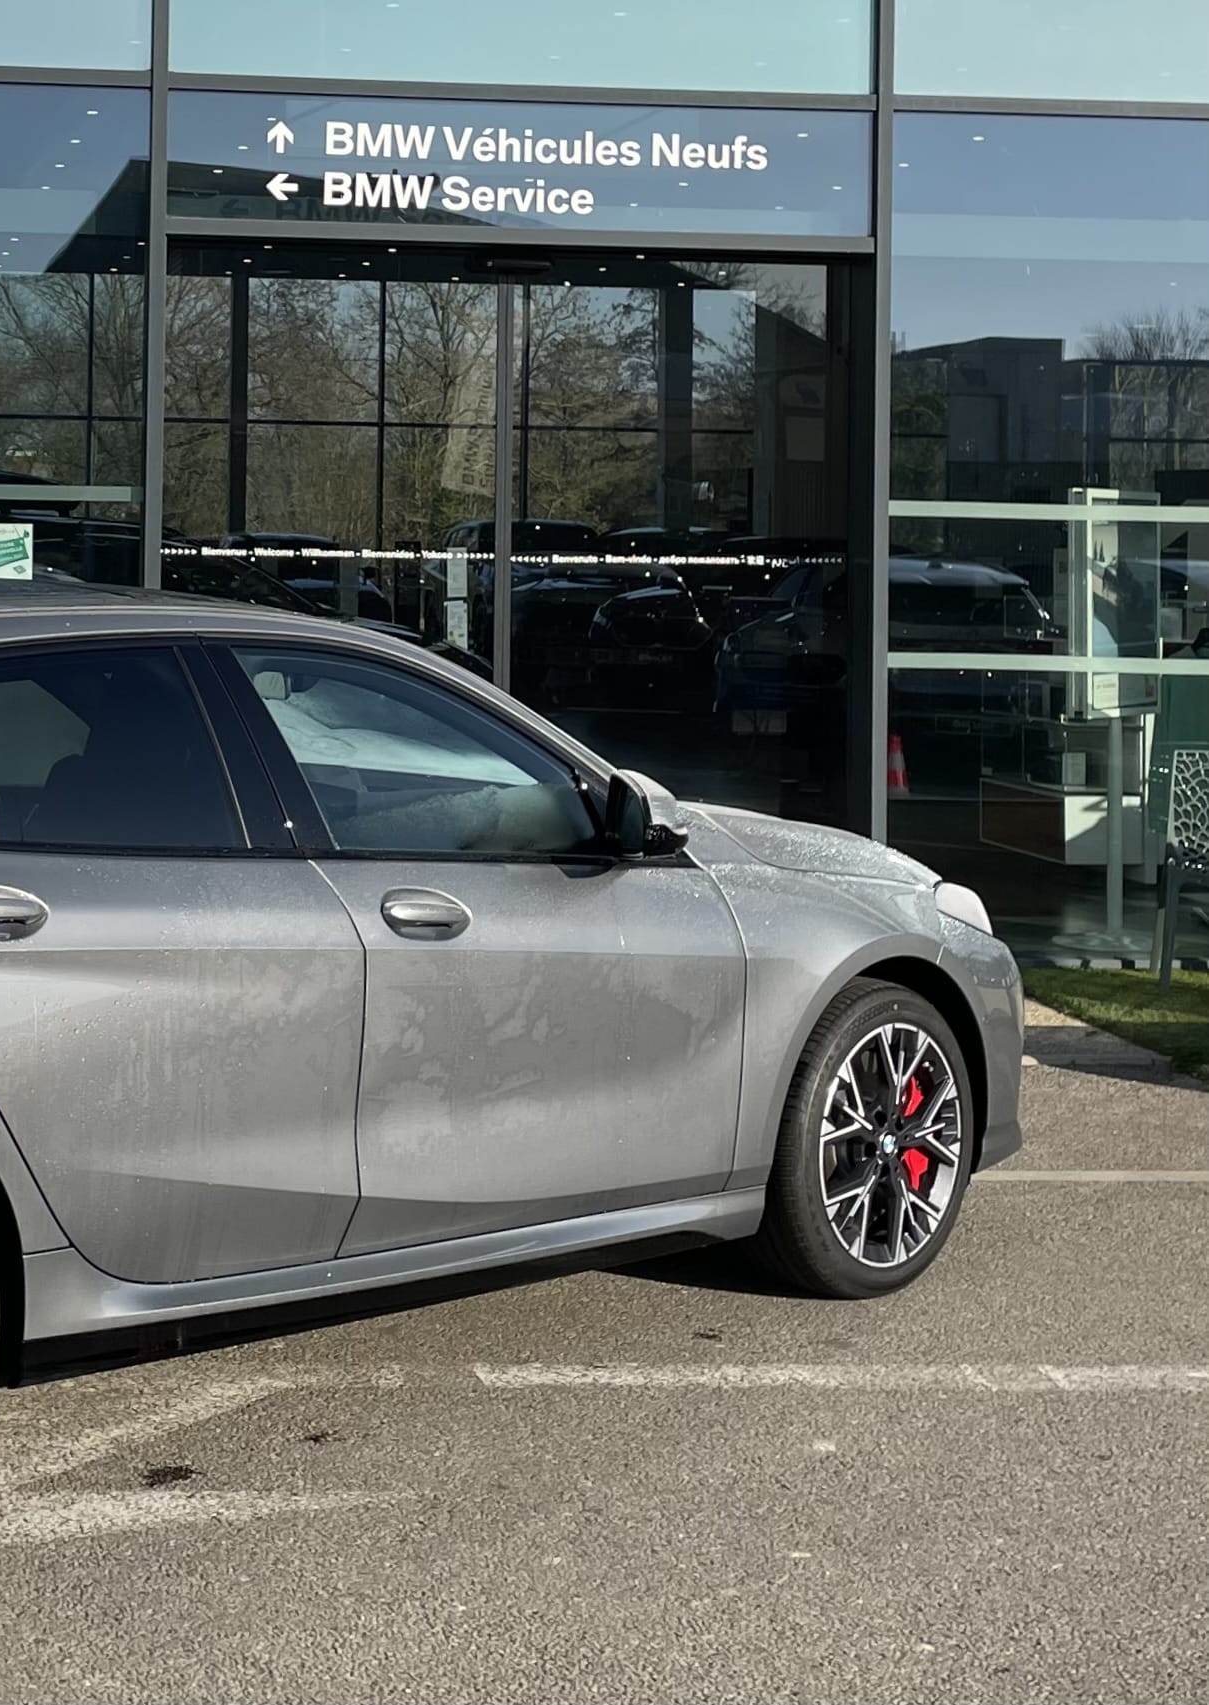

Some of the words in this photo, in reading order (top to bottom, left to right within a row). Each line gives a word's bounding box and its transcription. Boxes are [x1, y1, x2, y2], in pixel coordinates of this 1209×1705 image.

[324, 120, 435, 159] BMW
[442, 125, 641, 167] Véhicules
[651, 133, 769, 171] Neufs
[322, 171, 435, 210] BMW
[440, 175, 595, 216] Service
